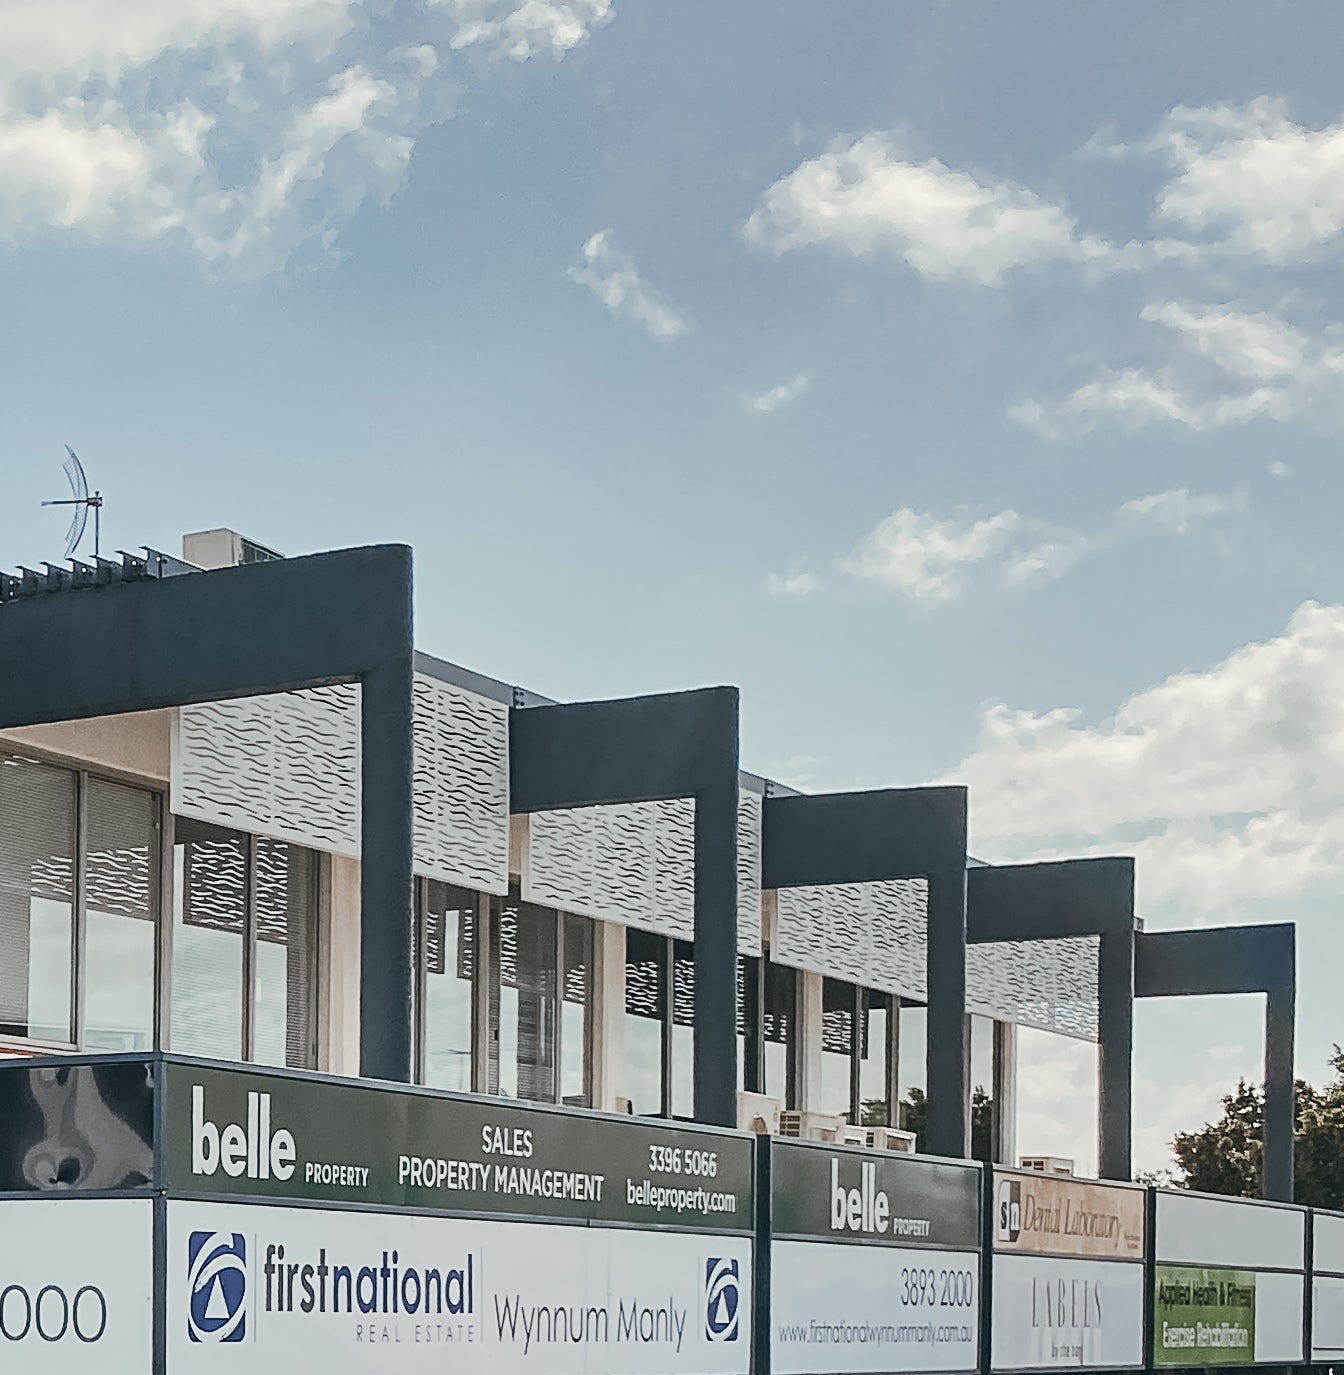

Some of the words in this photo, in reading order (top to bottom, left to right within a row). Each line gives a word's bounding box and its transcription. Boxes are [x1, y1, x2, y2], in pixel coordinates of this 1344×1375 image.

[191, 1085, 297, 1182] belle
[305, 1162, 369, 1187] PROPERTY
[481, 1124, 533, 1158] SALES
[398, 1155, 490, 1194] PROPERTY
[494, 1163, 605, 1202] MANAGEMENT
[649, 1145, 682, 1175] 3396
[684, 1149, 718, 1178] 5066
[626, 1178, 736, 1214] belleproperty.com
[830, 1157, 890, 1234] belle
[893, 1218, 931, 1237] PROPERTY
[900, 1268, 936, 1307] 3893
[939, 1270, 974, 1307] 2000
[1032, 1276, 1102, 1328] LABELS
[356, 1324, 401, 1342] REAL
[415, 1324, 474, 1343] ESTATE
[494, 1293, 609, 1355] Wynnum
[616, 1298, 687, 1352] Manly
